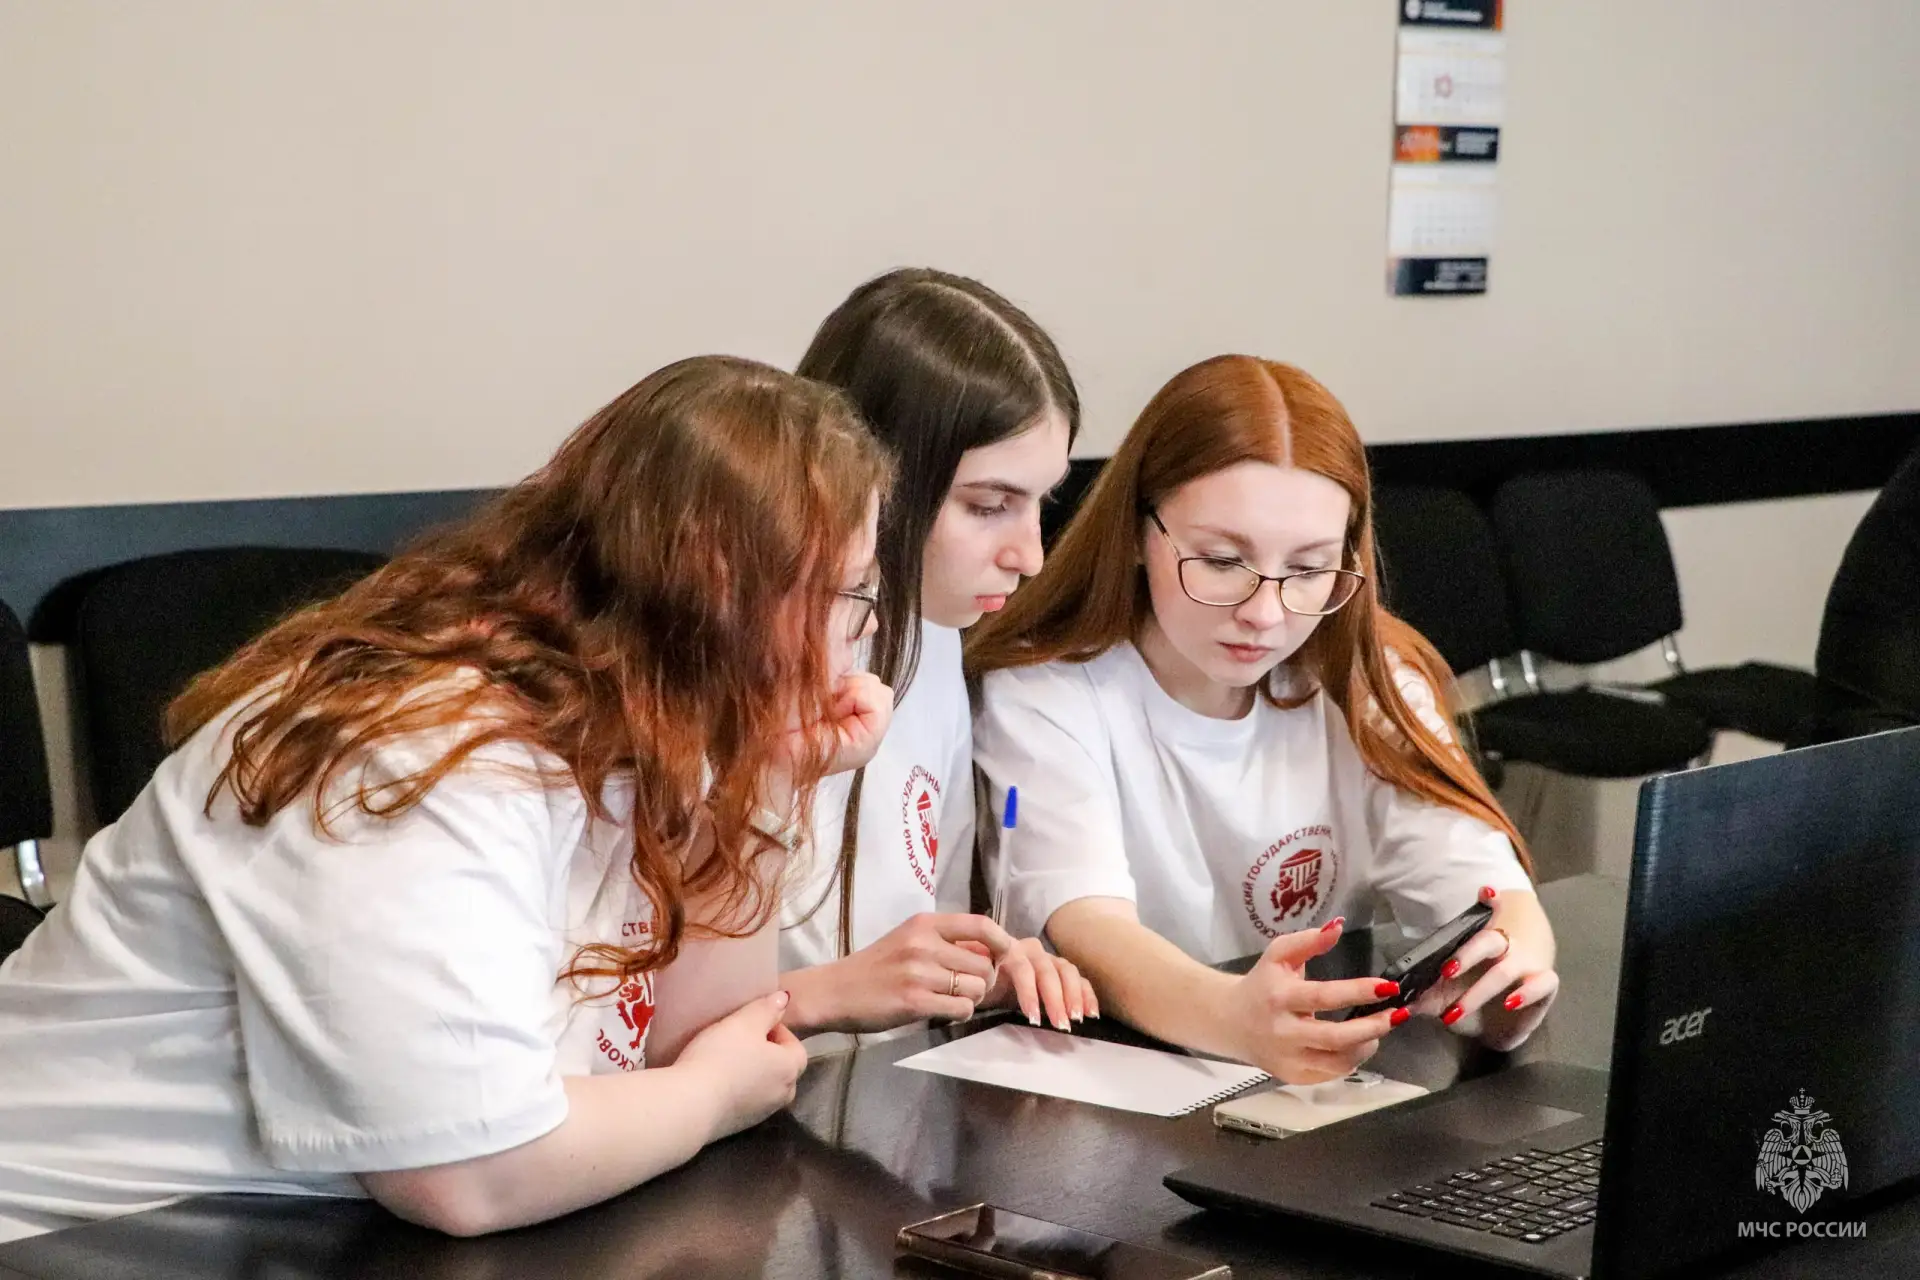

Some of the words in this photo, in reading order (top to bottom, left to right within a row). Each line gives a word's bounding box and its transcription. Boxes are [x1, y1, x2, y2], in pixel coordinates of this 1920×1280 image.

[903, 828, 936, 897] СКОВСКИЙ
[1242, 881, 1282, 938] СКОВСКИЙ
[1658, 1007, 1712, 1044] acer
